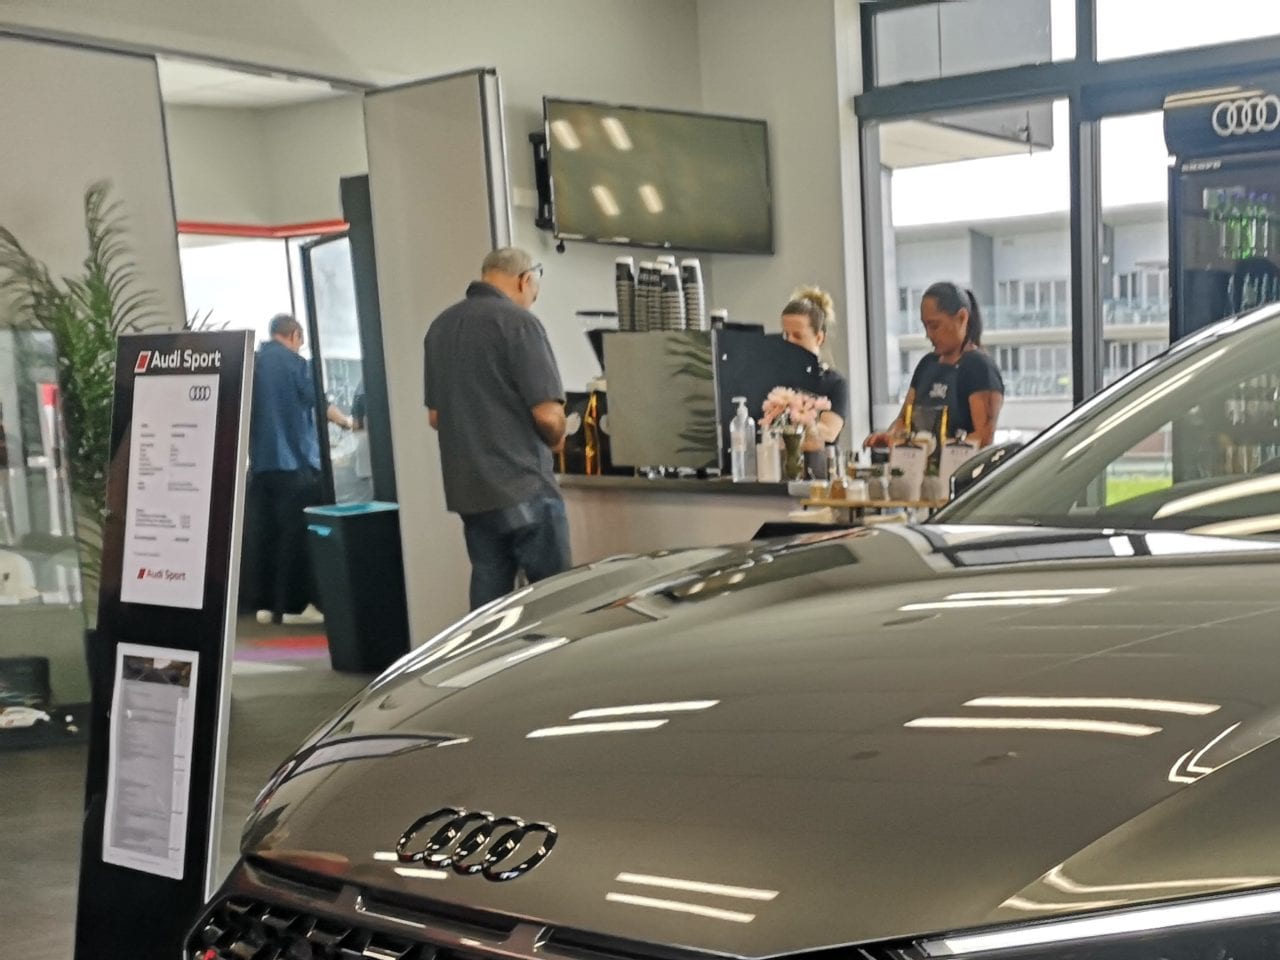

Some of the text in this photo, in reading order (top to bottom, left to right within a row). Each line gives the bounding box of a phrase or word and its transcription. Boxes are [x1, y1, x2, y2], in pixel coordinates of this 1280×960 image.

[150, 348, 221, 372] Audi Sport
[146, 567, 186, 582] Audi Sport
